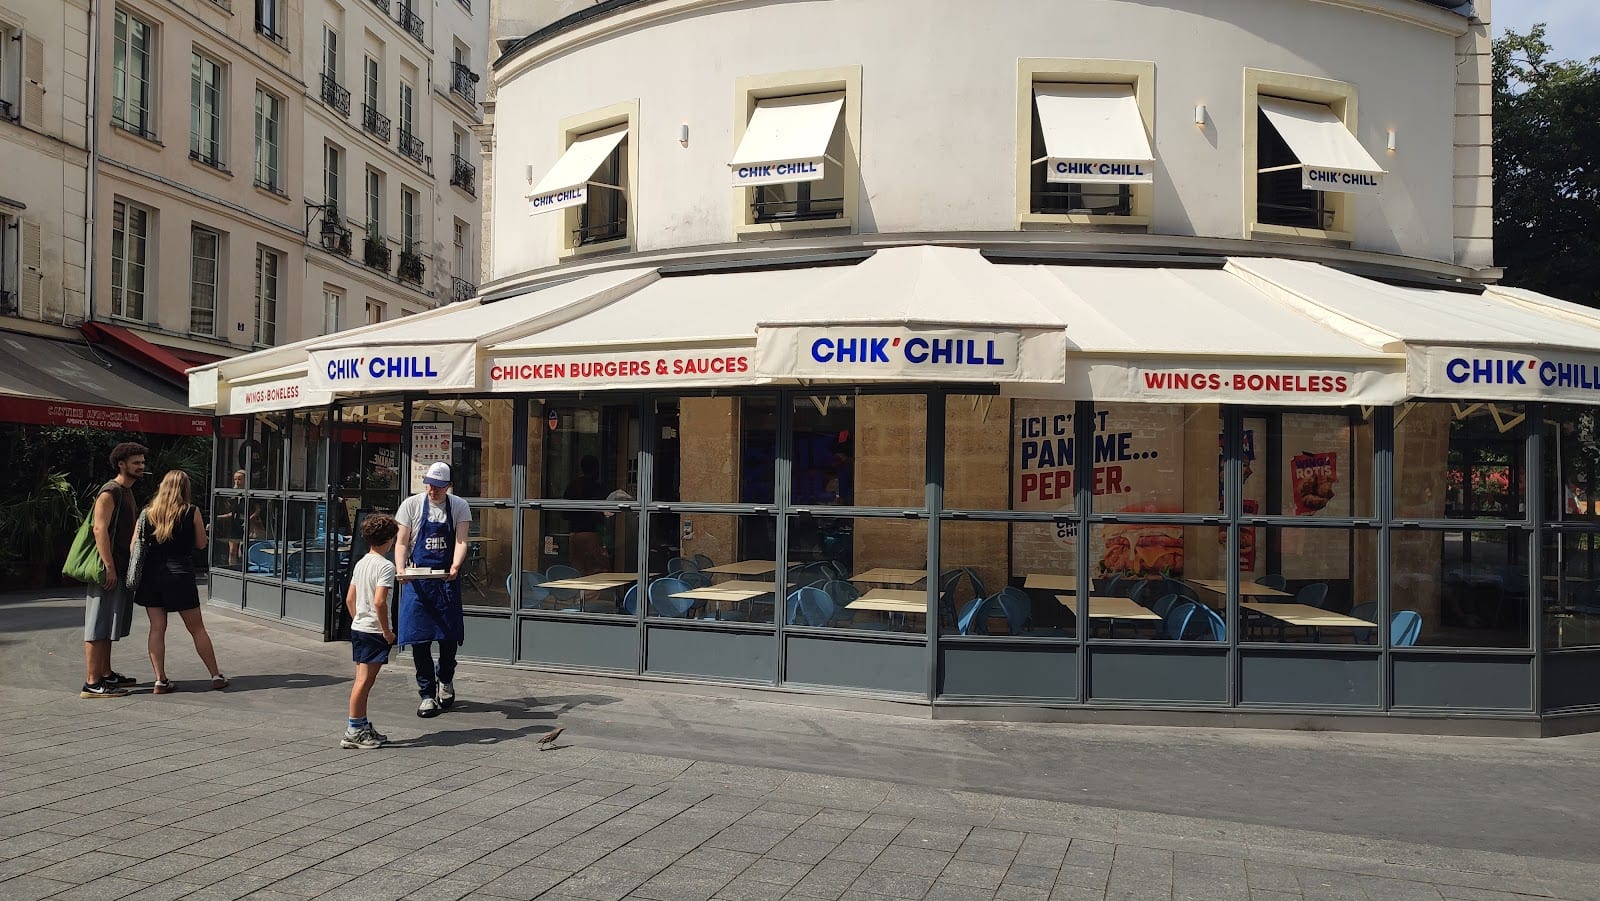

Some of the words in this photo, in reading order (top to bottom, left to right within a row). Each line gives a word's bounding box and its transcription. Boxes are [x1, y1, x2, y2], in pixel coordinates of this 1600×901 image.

[490, 363, 566, 381] CHICKEN
[570, 360, 650, 378] BURGERS
[655, 358, 669, 375] &
[673, 356, 748, 375] SAUCES
[1021, 416, 1047, 438] ICI
[1053, 411, 1109, 435] C'T
[1021, 432, 1158, 470] PANME...
[1021, 465, 1132, 502] PEPER.
